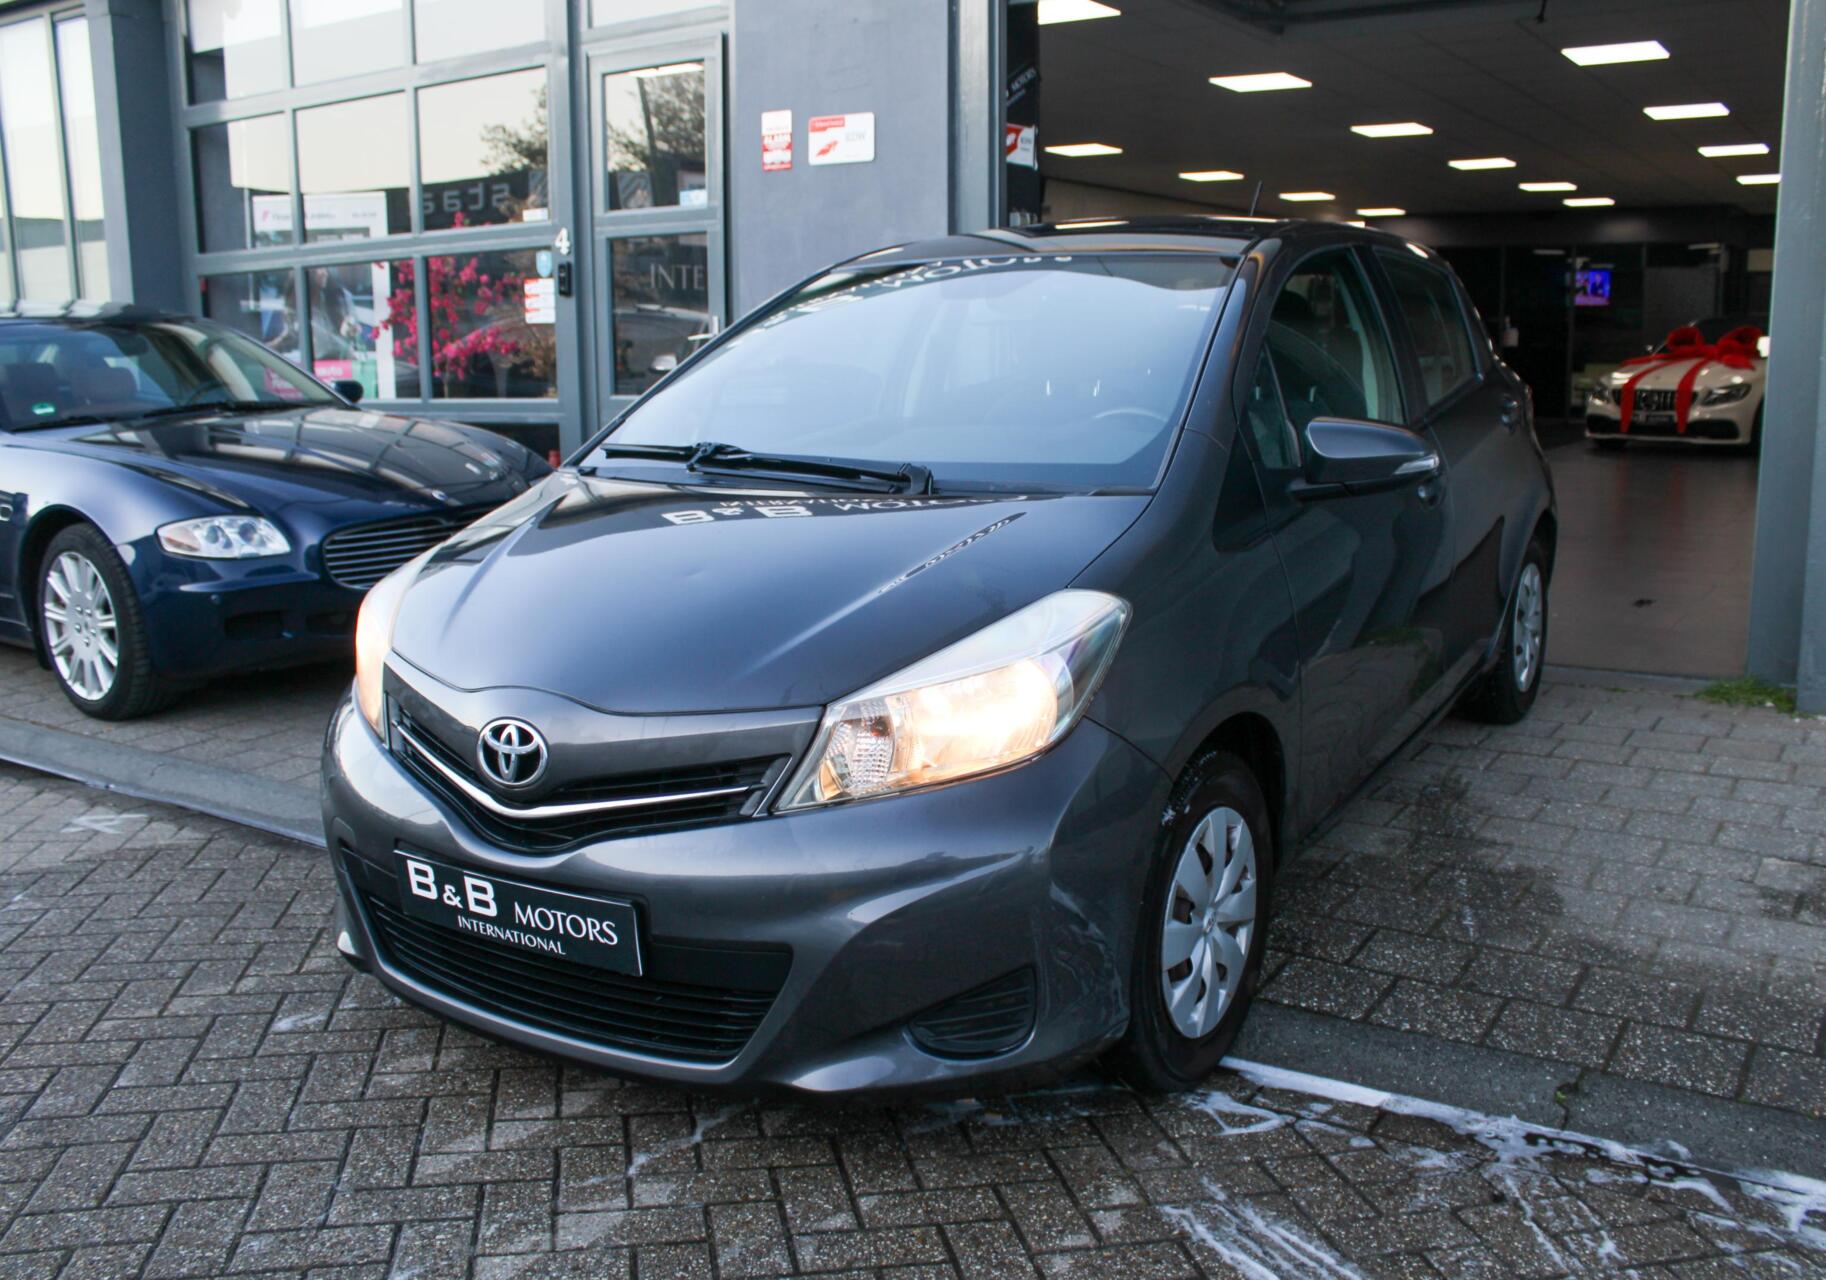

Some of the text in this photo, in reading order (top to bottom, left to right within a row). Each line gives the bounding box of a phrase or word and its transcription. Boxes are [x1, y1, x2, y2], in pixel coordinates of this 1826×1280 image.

[555, 227, 571, 255] 4
[650, 263, 705, 290] INTE
[457, 915, 566, 955] INTERNATIONAL
[514, 901, 618, 946] MOTORS
